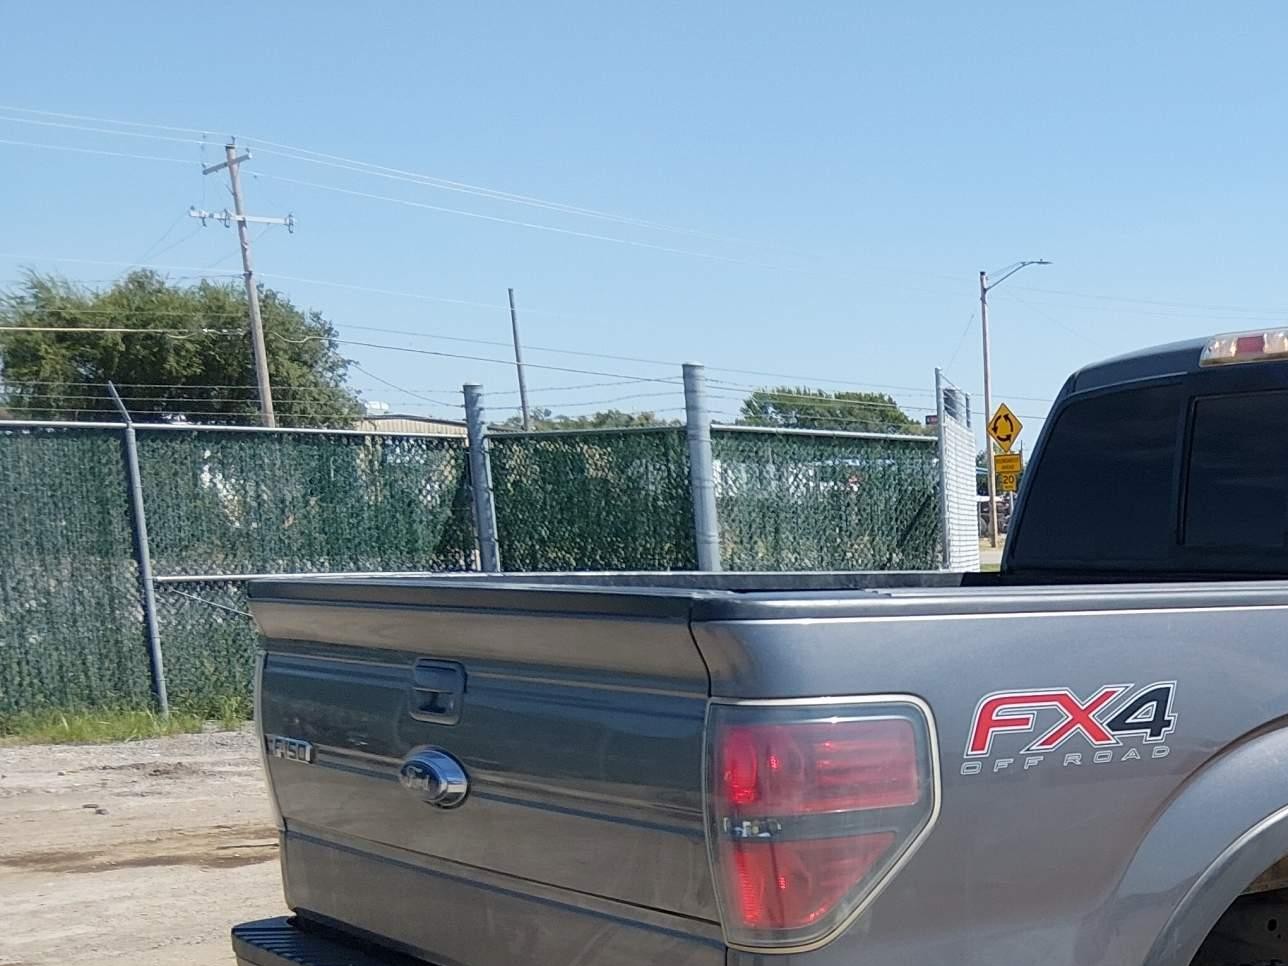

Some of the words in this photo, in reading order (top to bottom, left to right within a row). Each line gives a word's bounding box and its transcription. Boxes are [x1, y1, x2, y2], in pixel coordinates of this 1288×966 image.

[1003, 475, 1015, 485] 20
[964, 680, 1178, 758] FX4
[960, 755, 1044, 776] OFF
[1063, 745, 1171, 767] ROAD
